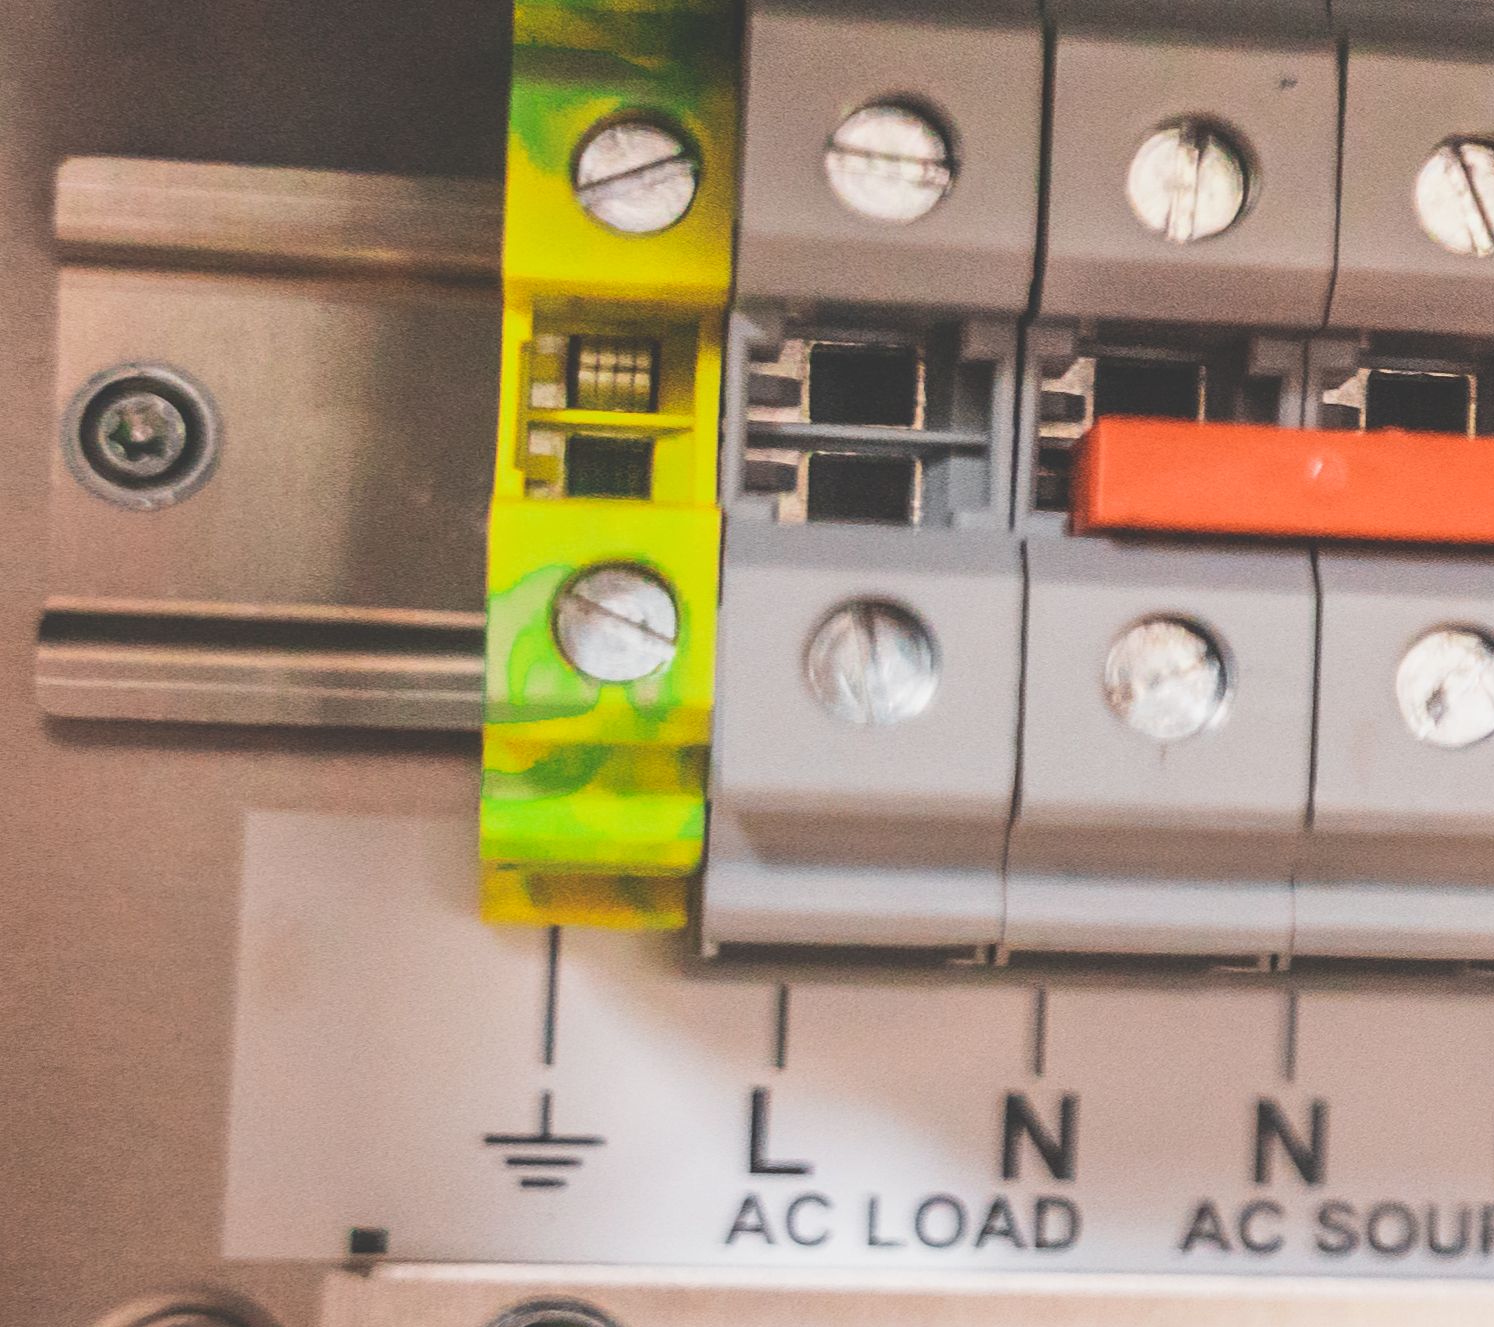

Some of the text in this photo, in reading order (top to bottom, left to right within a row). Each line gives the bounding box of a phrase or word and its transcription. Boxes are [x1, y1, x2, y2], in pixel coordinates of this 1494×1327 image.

[746, 1087, 814, 1177] L
[1002, 1092, 1082, 1183] N
[1252, 1098, 1329, 1188] N
[724, 1193, 1086, 1254] AC LOAD
[1178, 1199, 1288, 1257] AC
